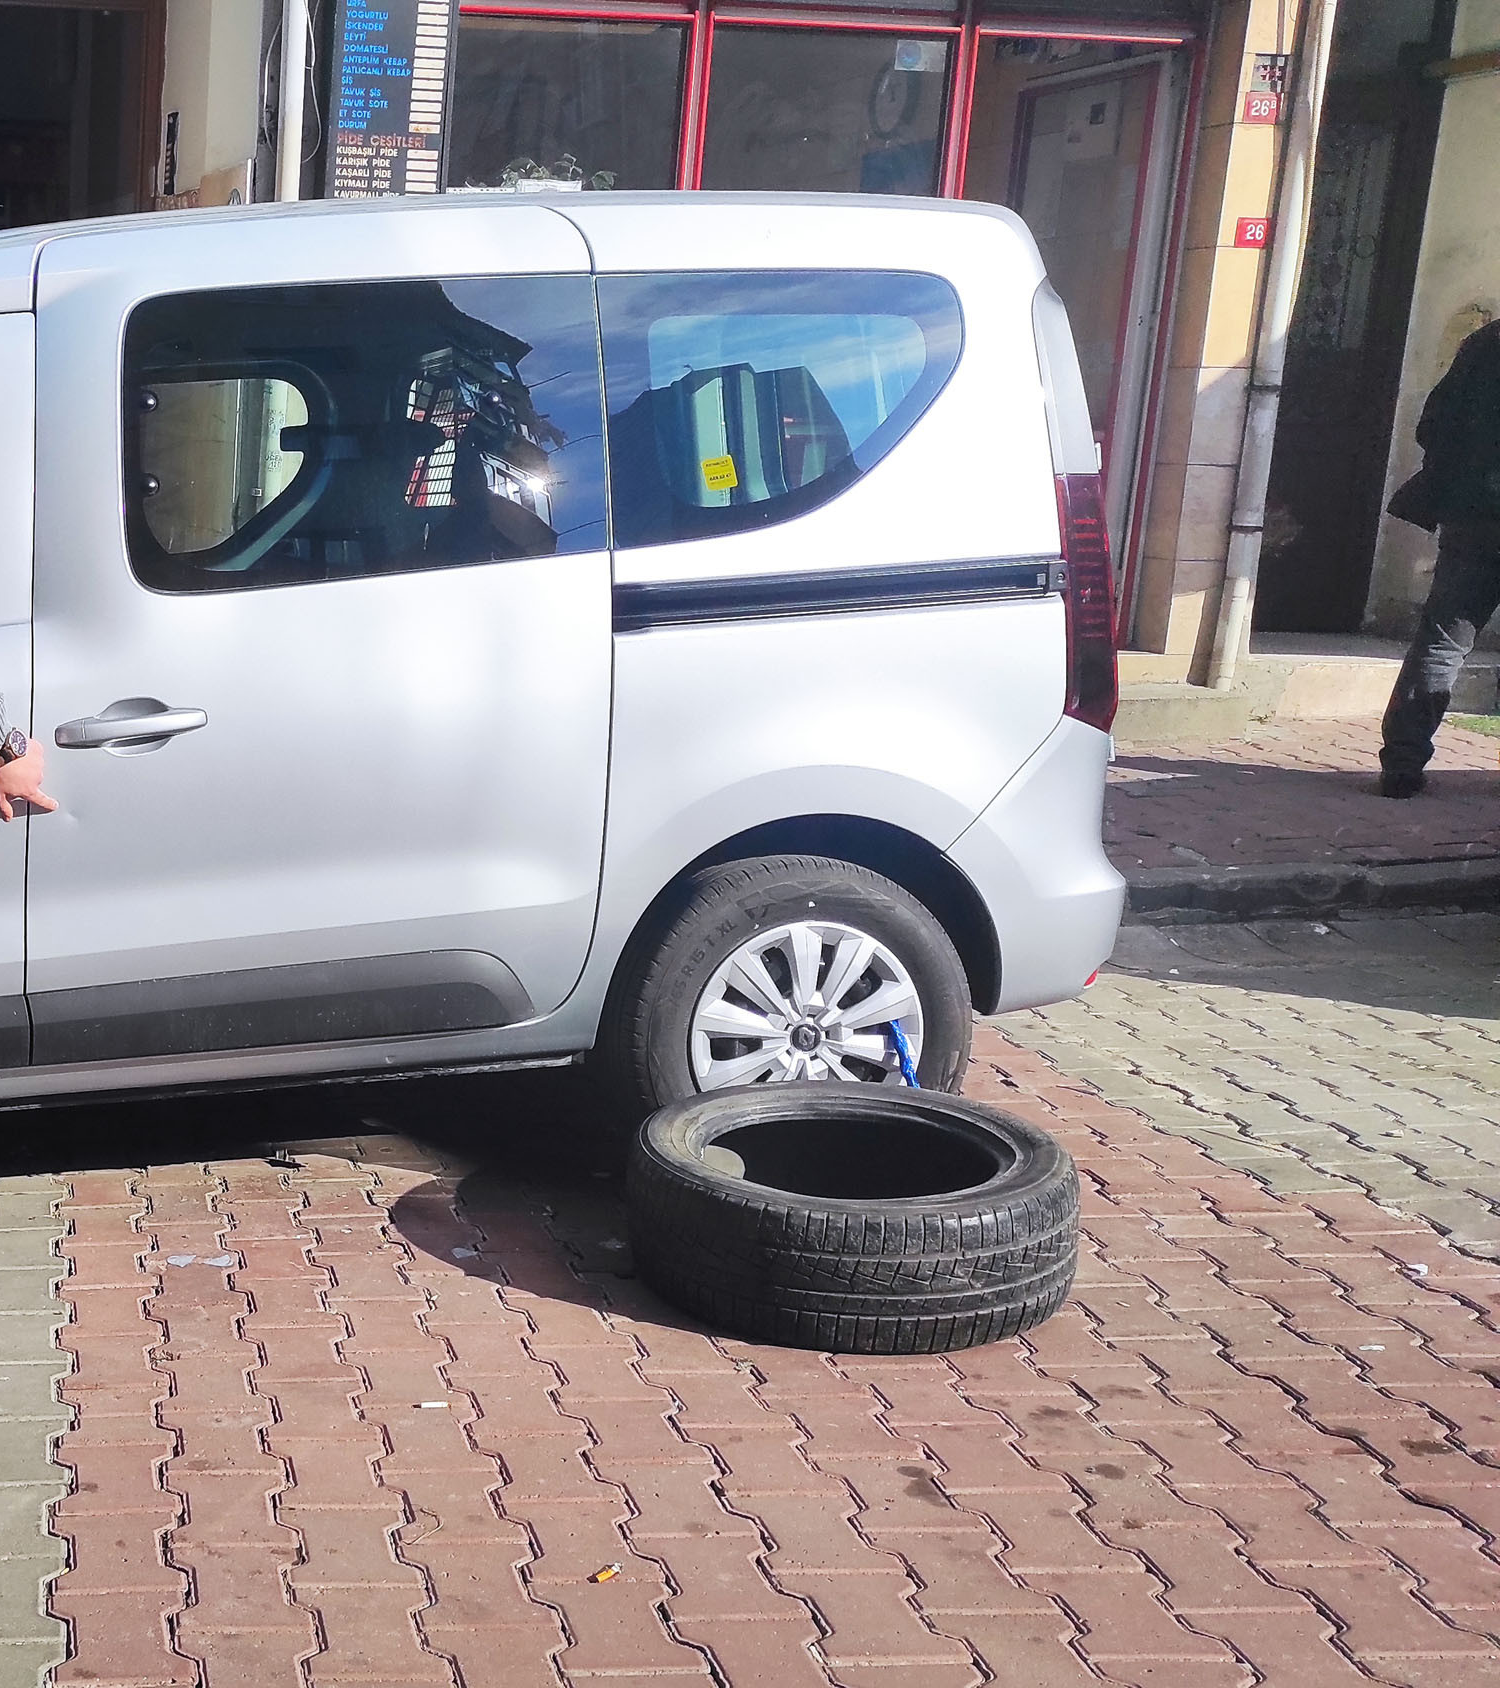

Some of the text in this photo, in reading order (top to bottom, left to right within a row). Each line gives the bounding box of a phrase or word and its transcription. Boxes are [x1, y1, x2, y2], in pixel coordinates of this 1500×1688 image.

[345, 20, 384, 31] İSKENDER
[343, 44, 388, 54] DOMATESLİ
[383, 58, 407, 67] KEBAP
[342, 66, 411, 77] PATLICANLI KEBAP
[341, 87, 365, 96] TAVUK
[340, 98, 365, 107] TAVUK
[339, 109, 348, 118] ET
[336, 145, 399, 157] KUŞBAŞILI PİDE
[335, 156, 391, 167] KARIŞIK PİDE
[335, 168, 392, 178] KAŞARLI PİDE
[334, 178, 390, 189] KIYMALI PİDE
[1246, 223, 1265, 240] 26
